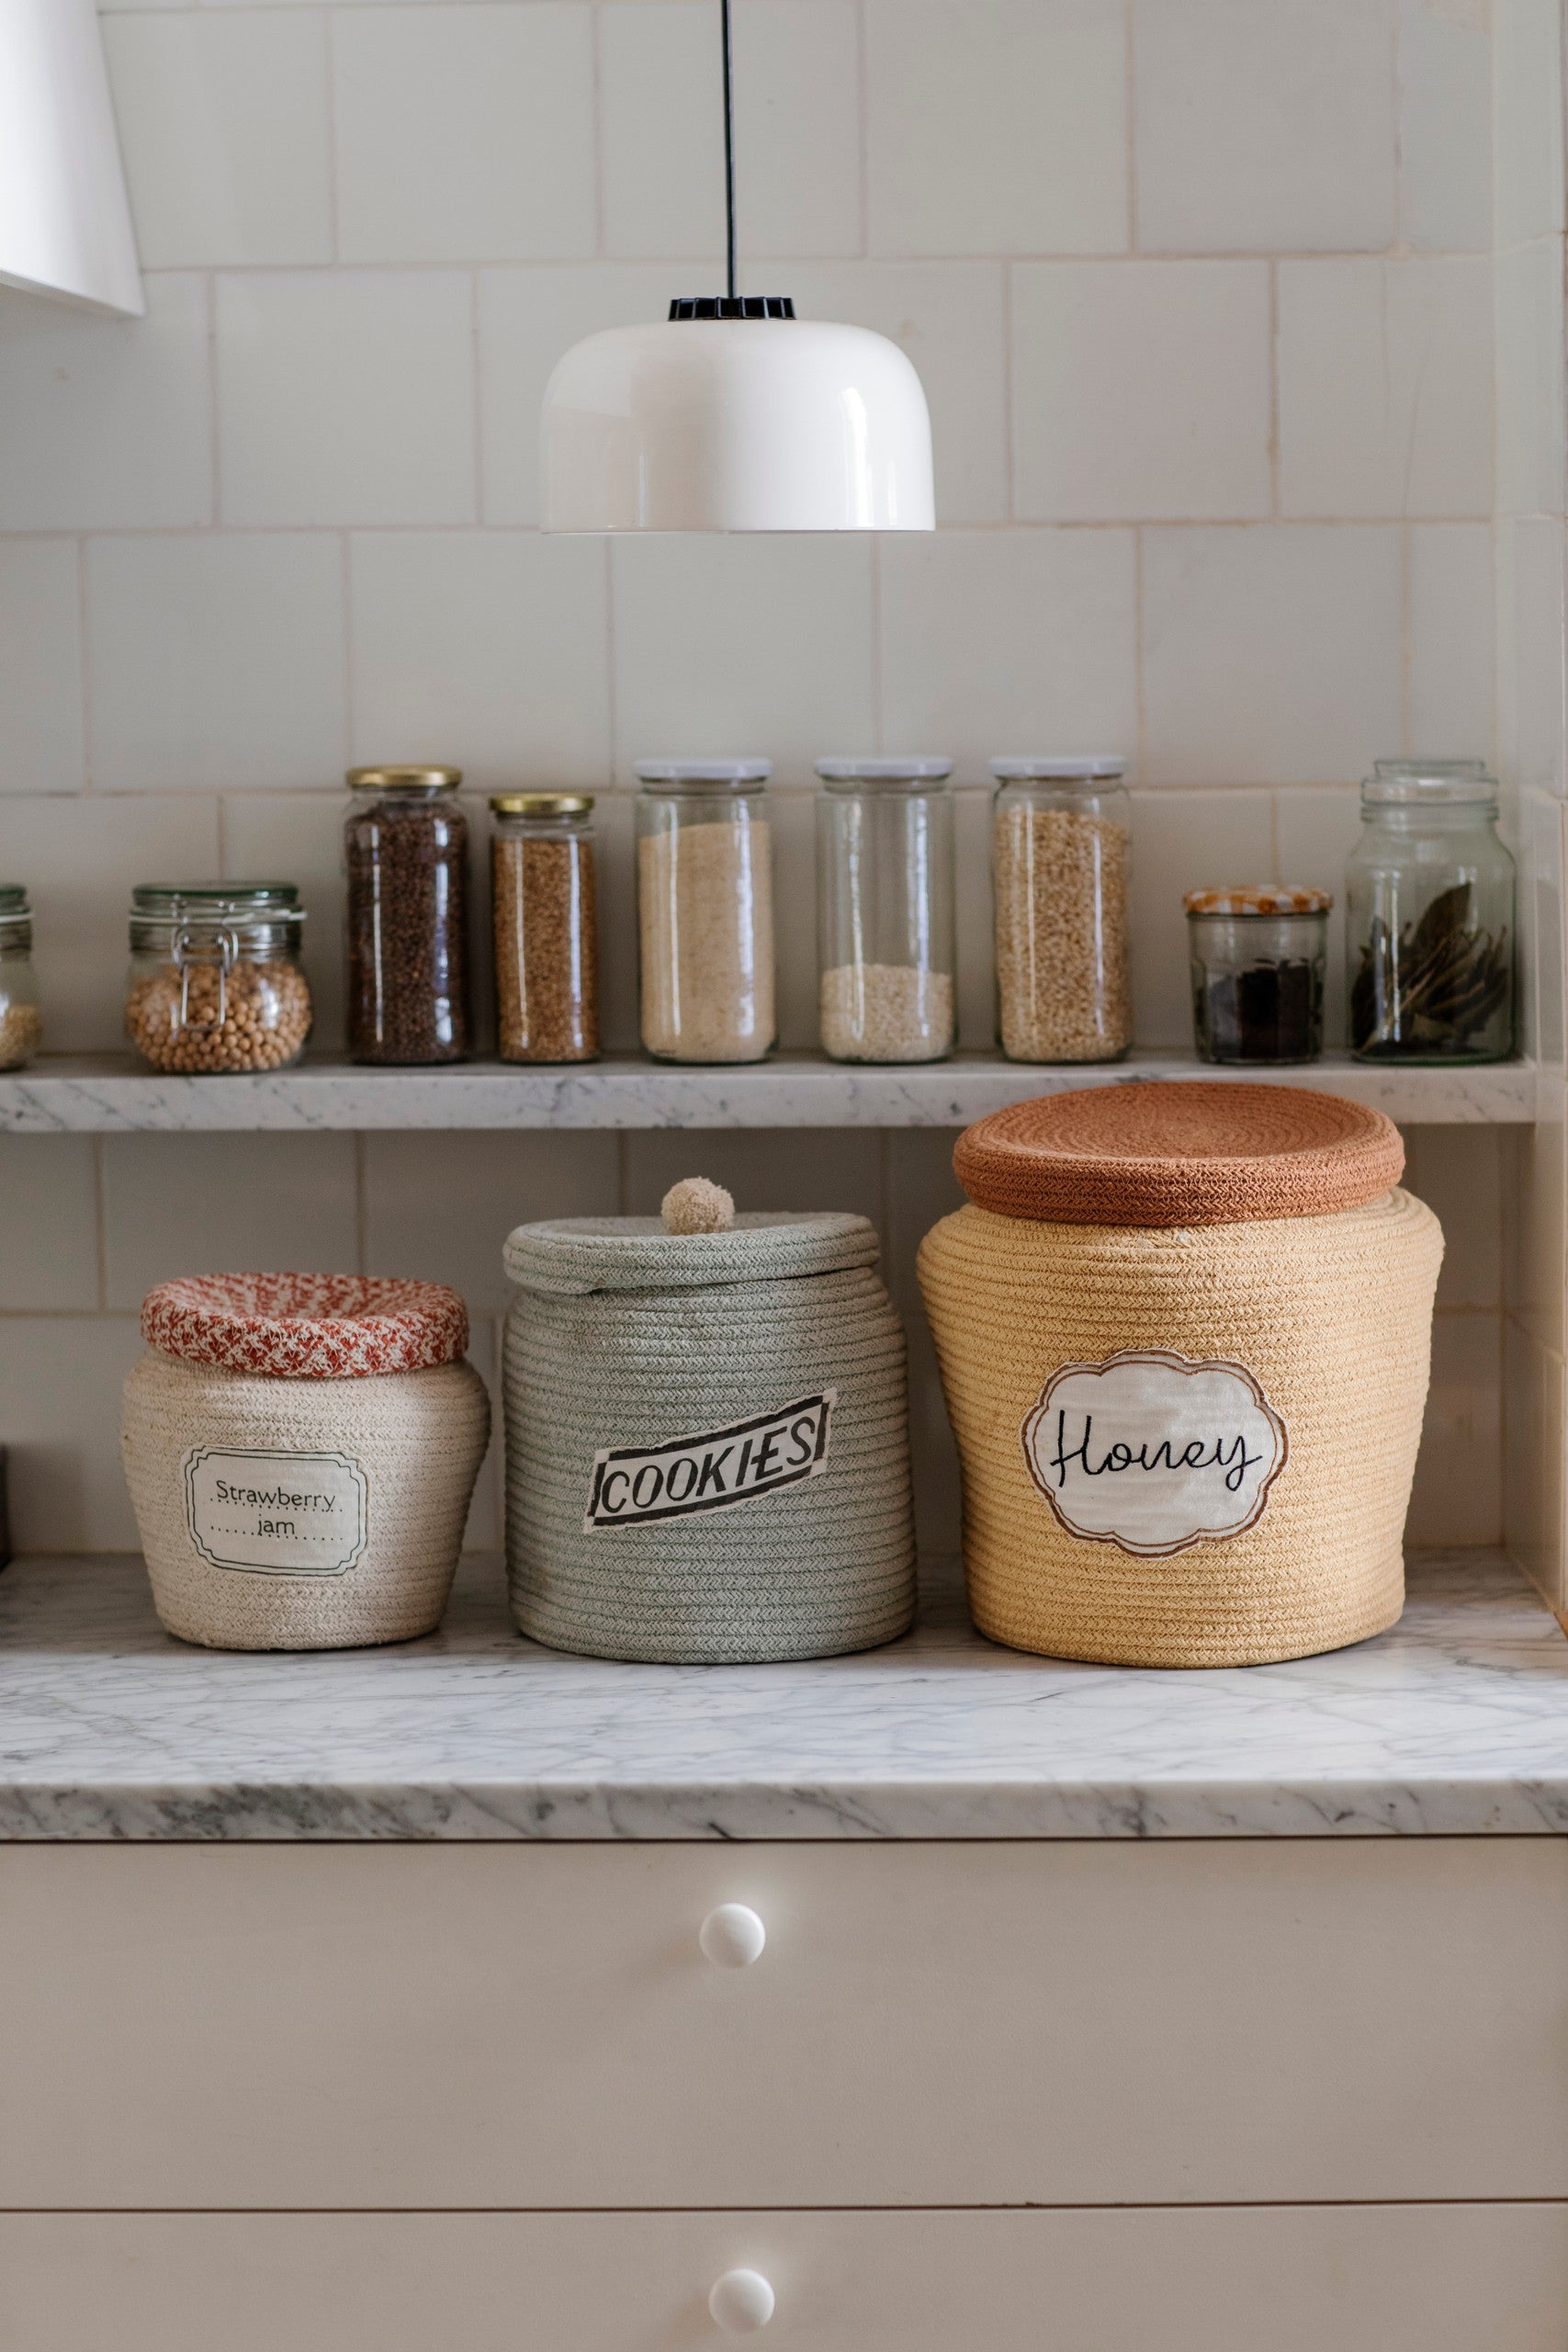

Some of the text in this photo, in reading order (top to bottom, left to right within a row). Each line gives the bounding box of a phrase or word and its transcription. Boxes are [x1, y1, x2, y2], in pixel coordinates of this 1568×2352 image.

[601, 1416, 816, 1513] COOKIES
[1050, 1409, 1263, 1492] Honey
[216, 1479, 336, 1512] Strawberry
[257, 1513, 295, 1536] jam
